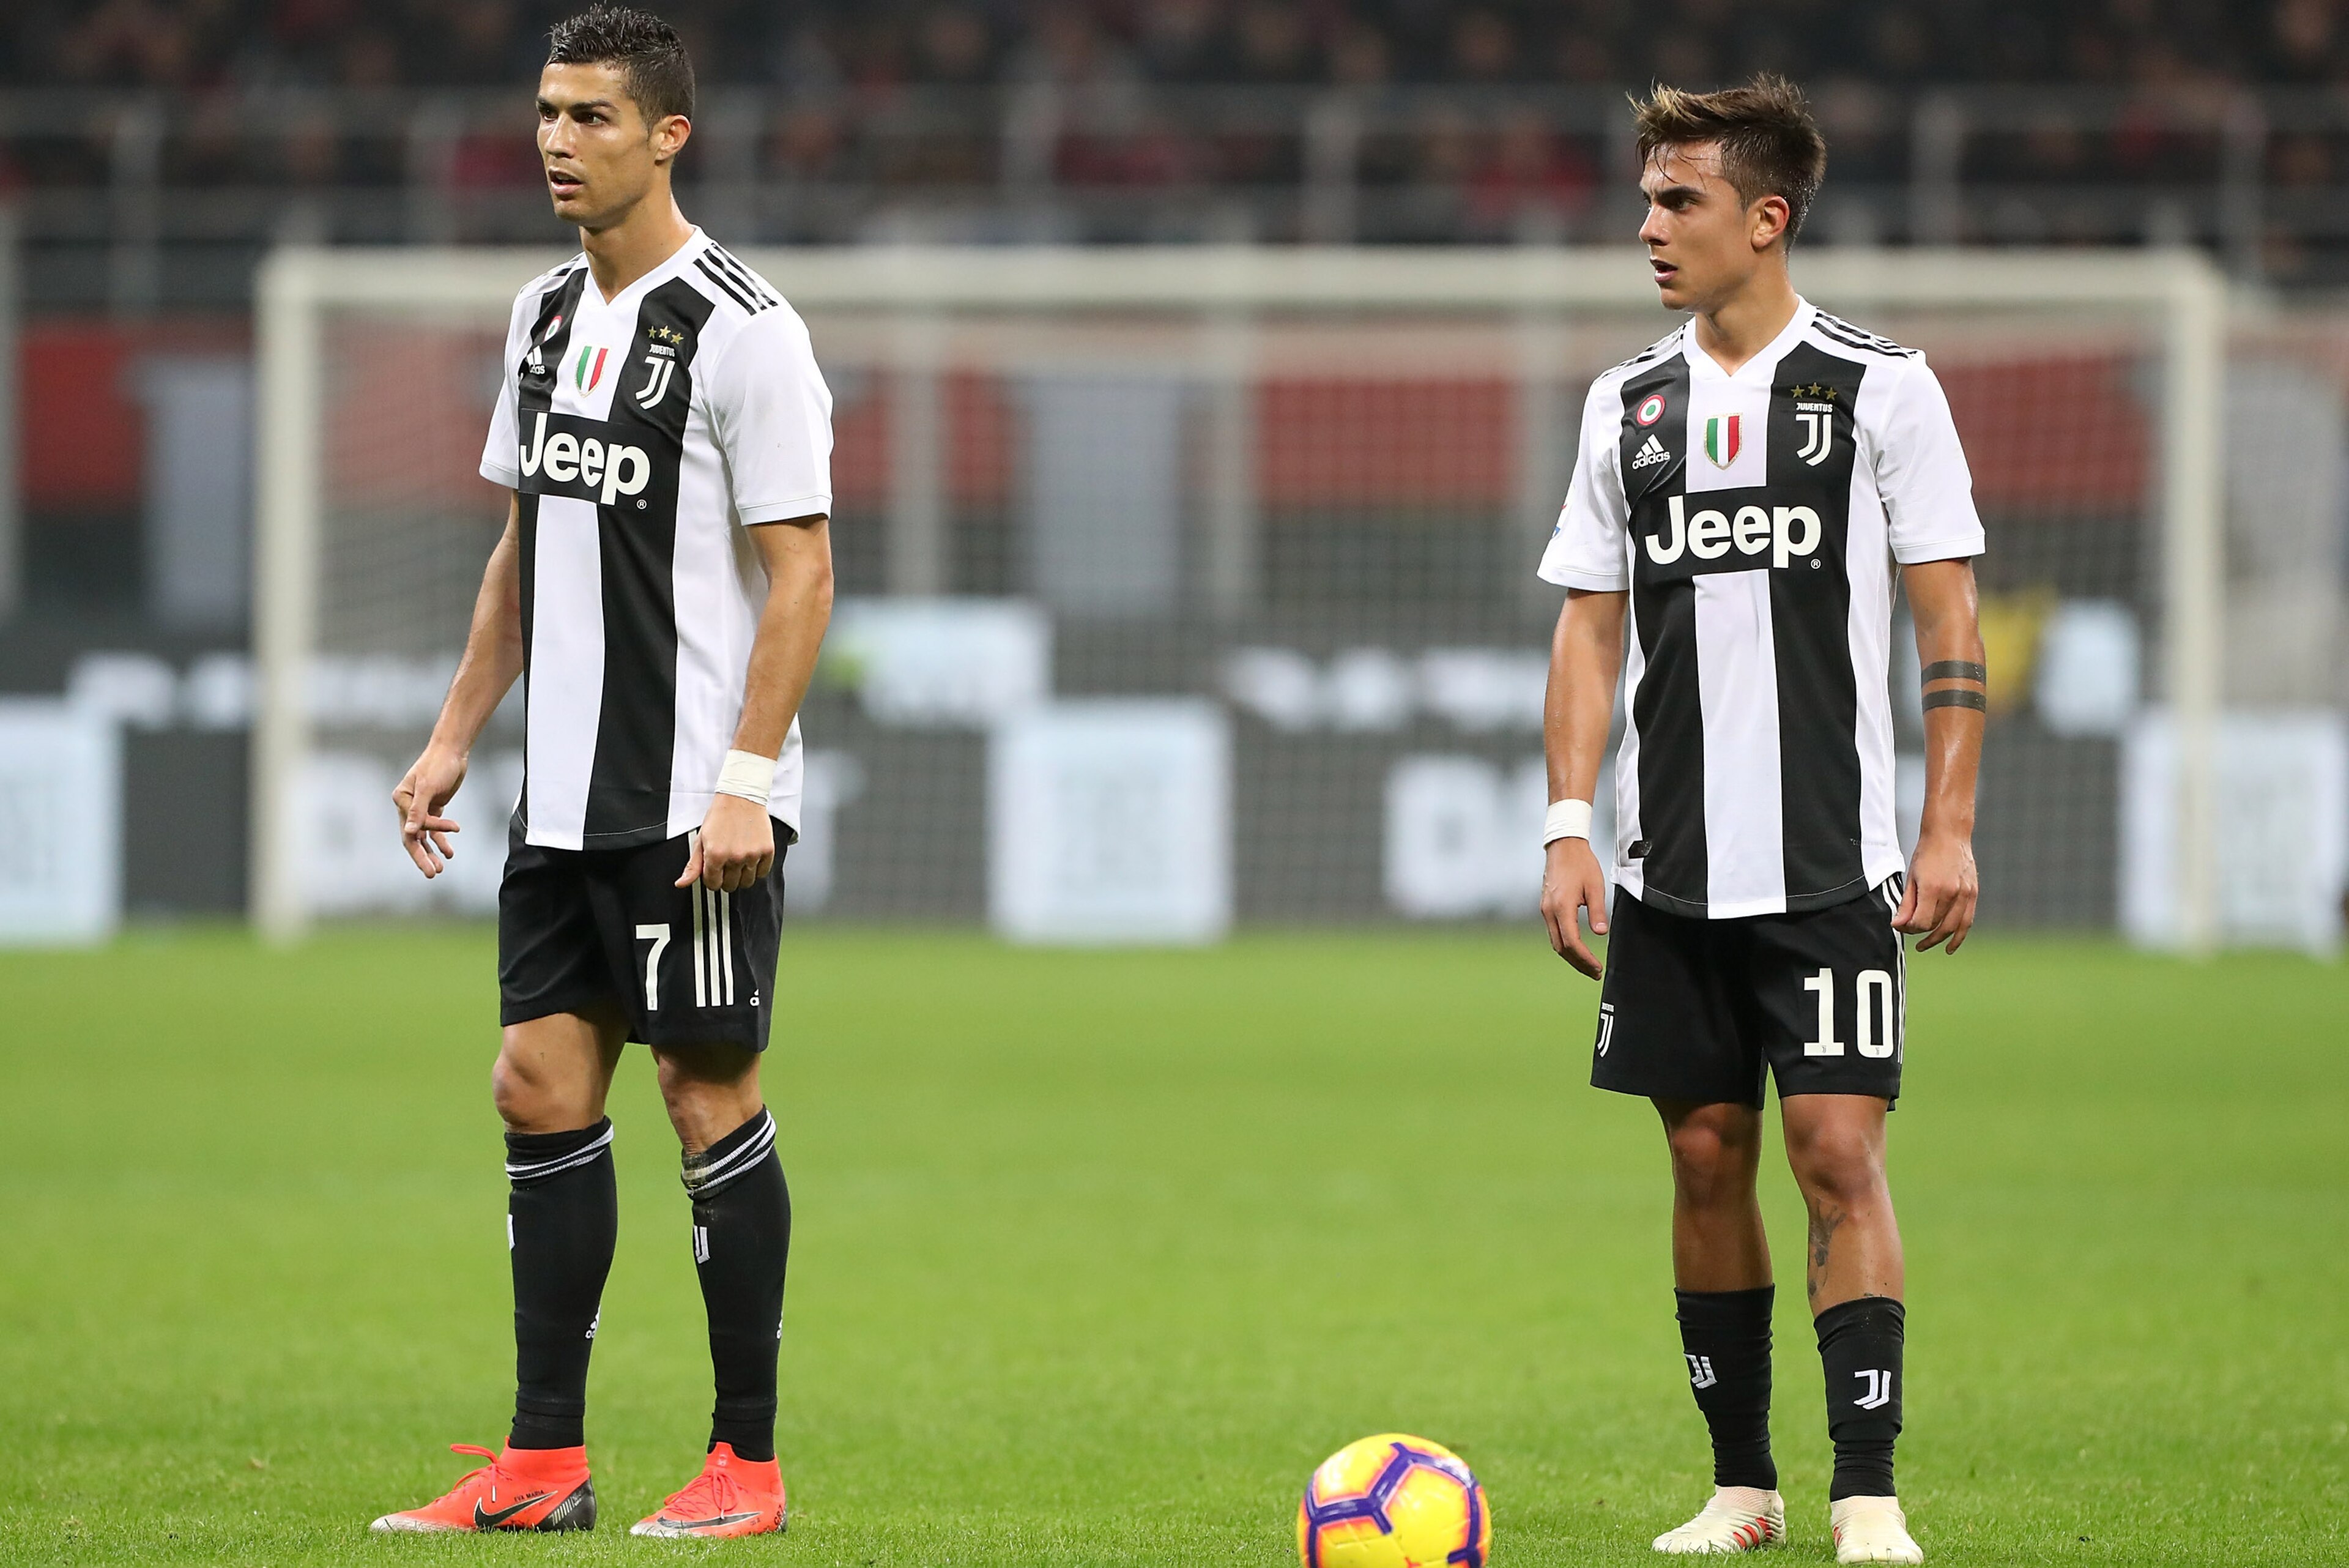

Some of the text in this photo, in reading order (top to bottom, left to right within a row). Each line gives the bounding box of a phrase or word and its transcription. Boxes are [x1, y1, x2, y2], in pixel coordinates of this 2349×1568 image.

[649, 344, 675, 357] JUVENTUS
[1796, 403, 1833, 412] JUVENTUS
[520, 412, 651, 506] Jeep
[1632, 451, 1671, 470] adidas
[1645, 495, 1822, 568] Jeep
[636, 923, 670, 1011] 7
[1804, 967, 1894, 1058] 10
